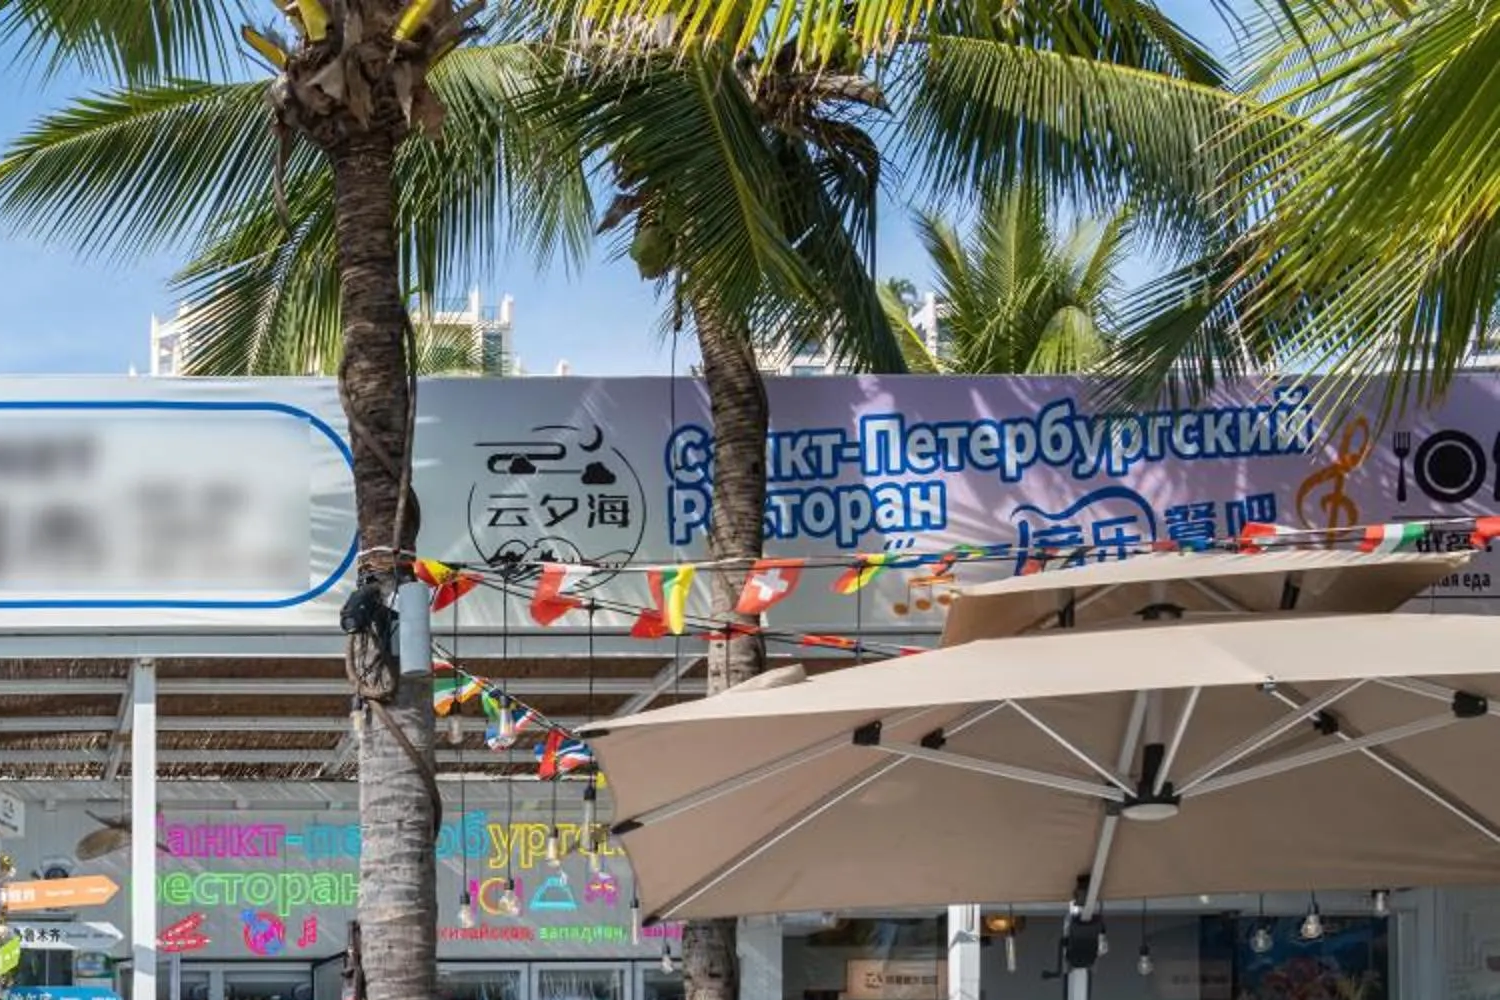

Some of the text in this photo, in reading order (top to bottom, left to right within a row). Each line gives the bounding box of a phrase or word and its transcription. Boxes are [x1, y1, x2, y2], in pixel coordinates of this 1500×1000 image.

[666, 386, 1317, 484] Скт-Петербургский
[487, 494, 629, 528] 云夕海
[668, 481, 947, 548] Рторан
[156, 871, 362, 916] есторан
